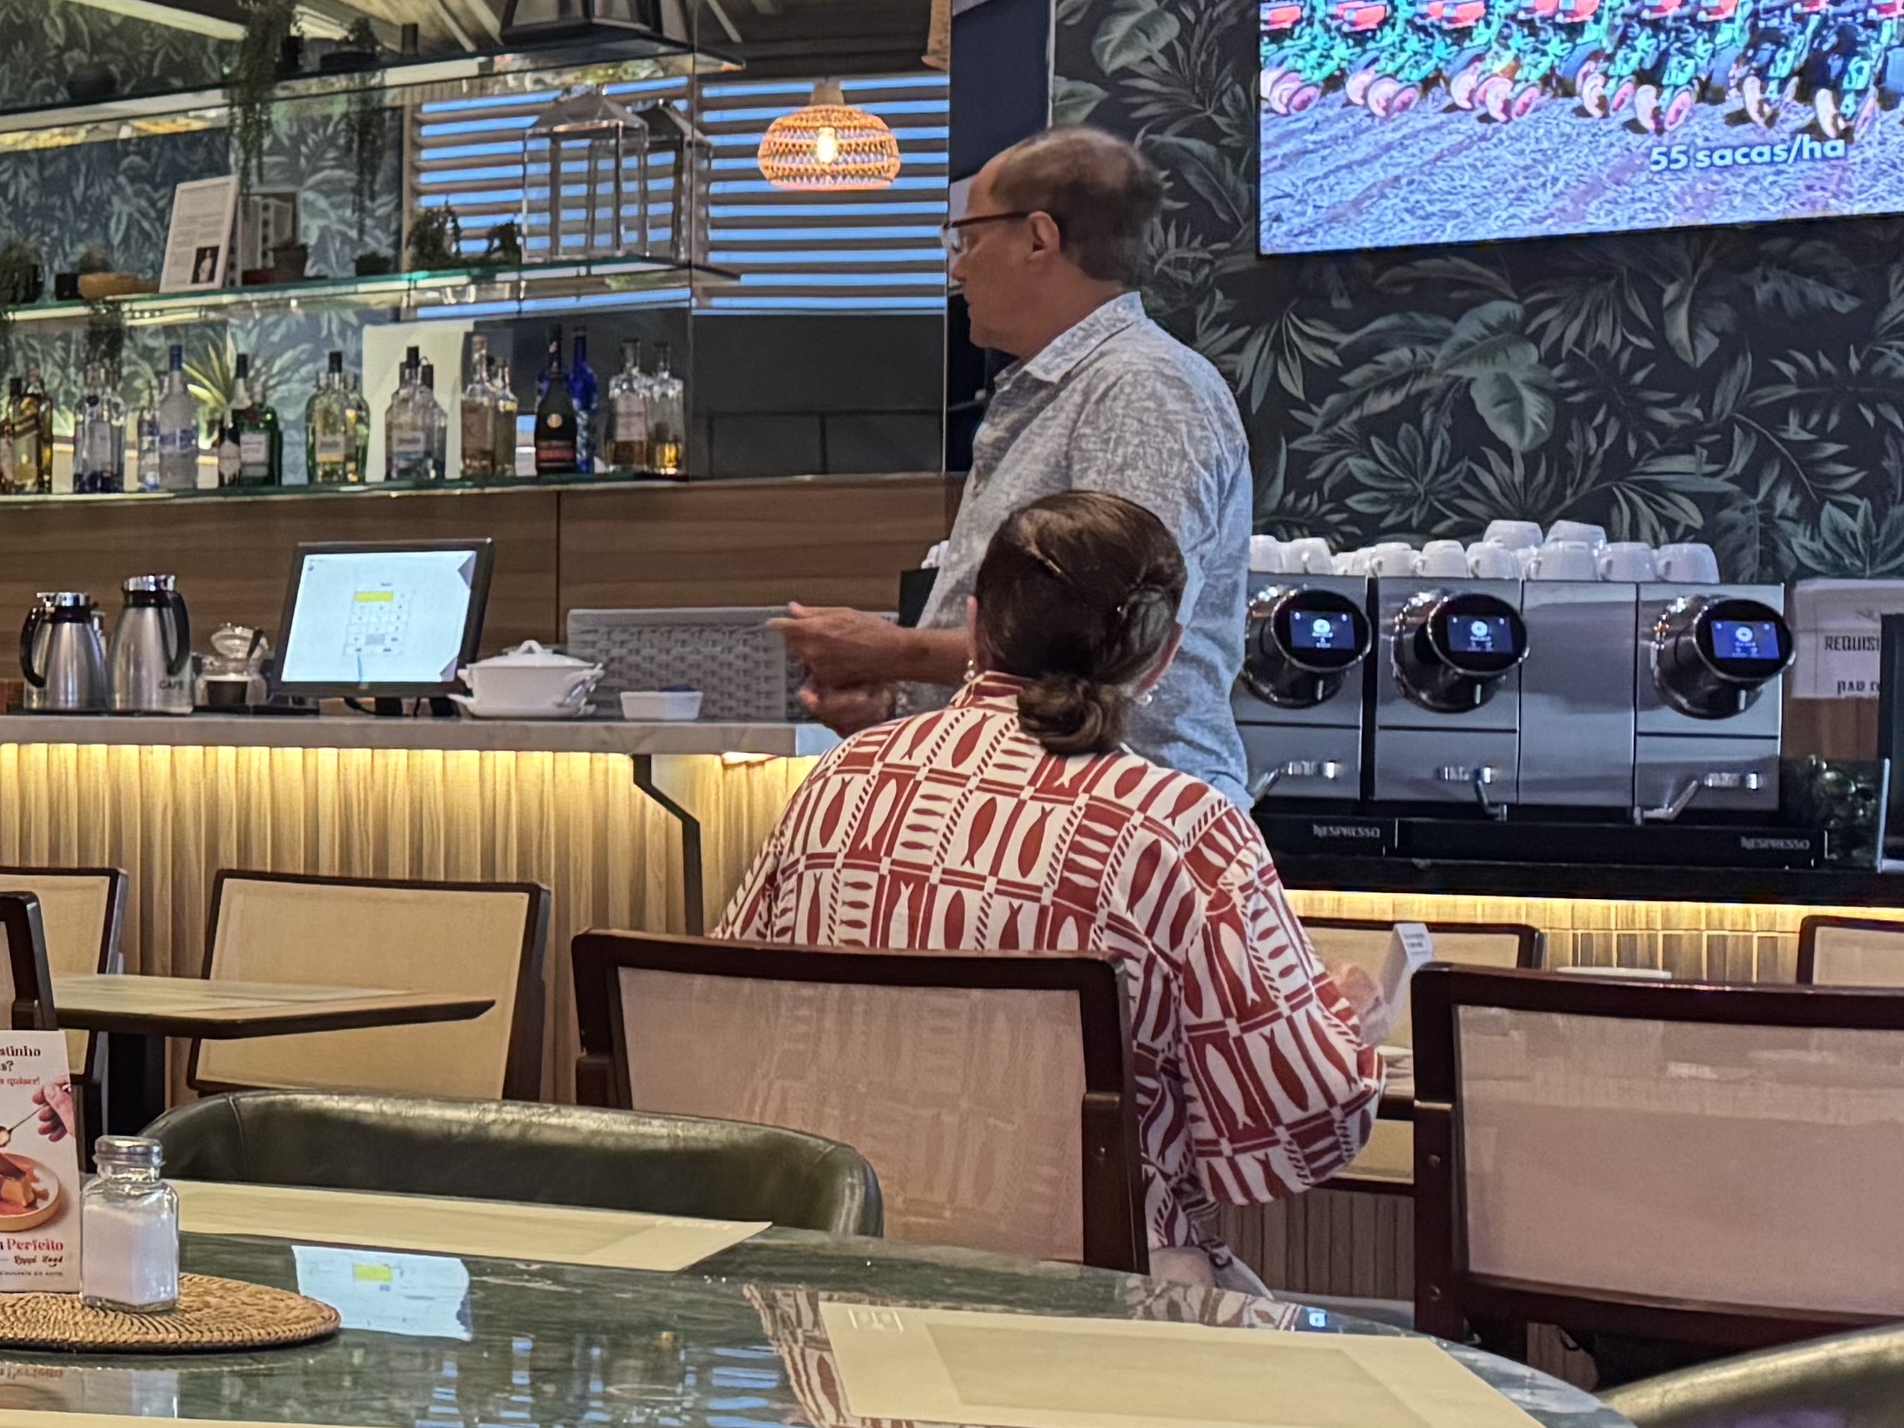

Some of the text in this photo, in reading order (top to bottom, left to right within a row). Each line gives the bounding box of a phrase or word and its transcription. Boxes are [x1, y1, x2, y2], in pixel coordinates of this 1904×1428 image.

[1649, 133, 1846, 171] 55 sacas/ha
[1824, 635, 1880, 652] REQUISI
[6, 1237, 64, 1252] Perfeito
